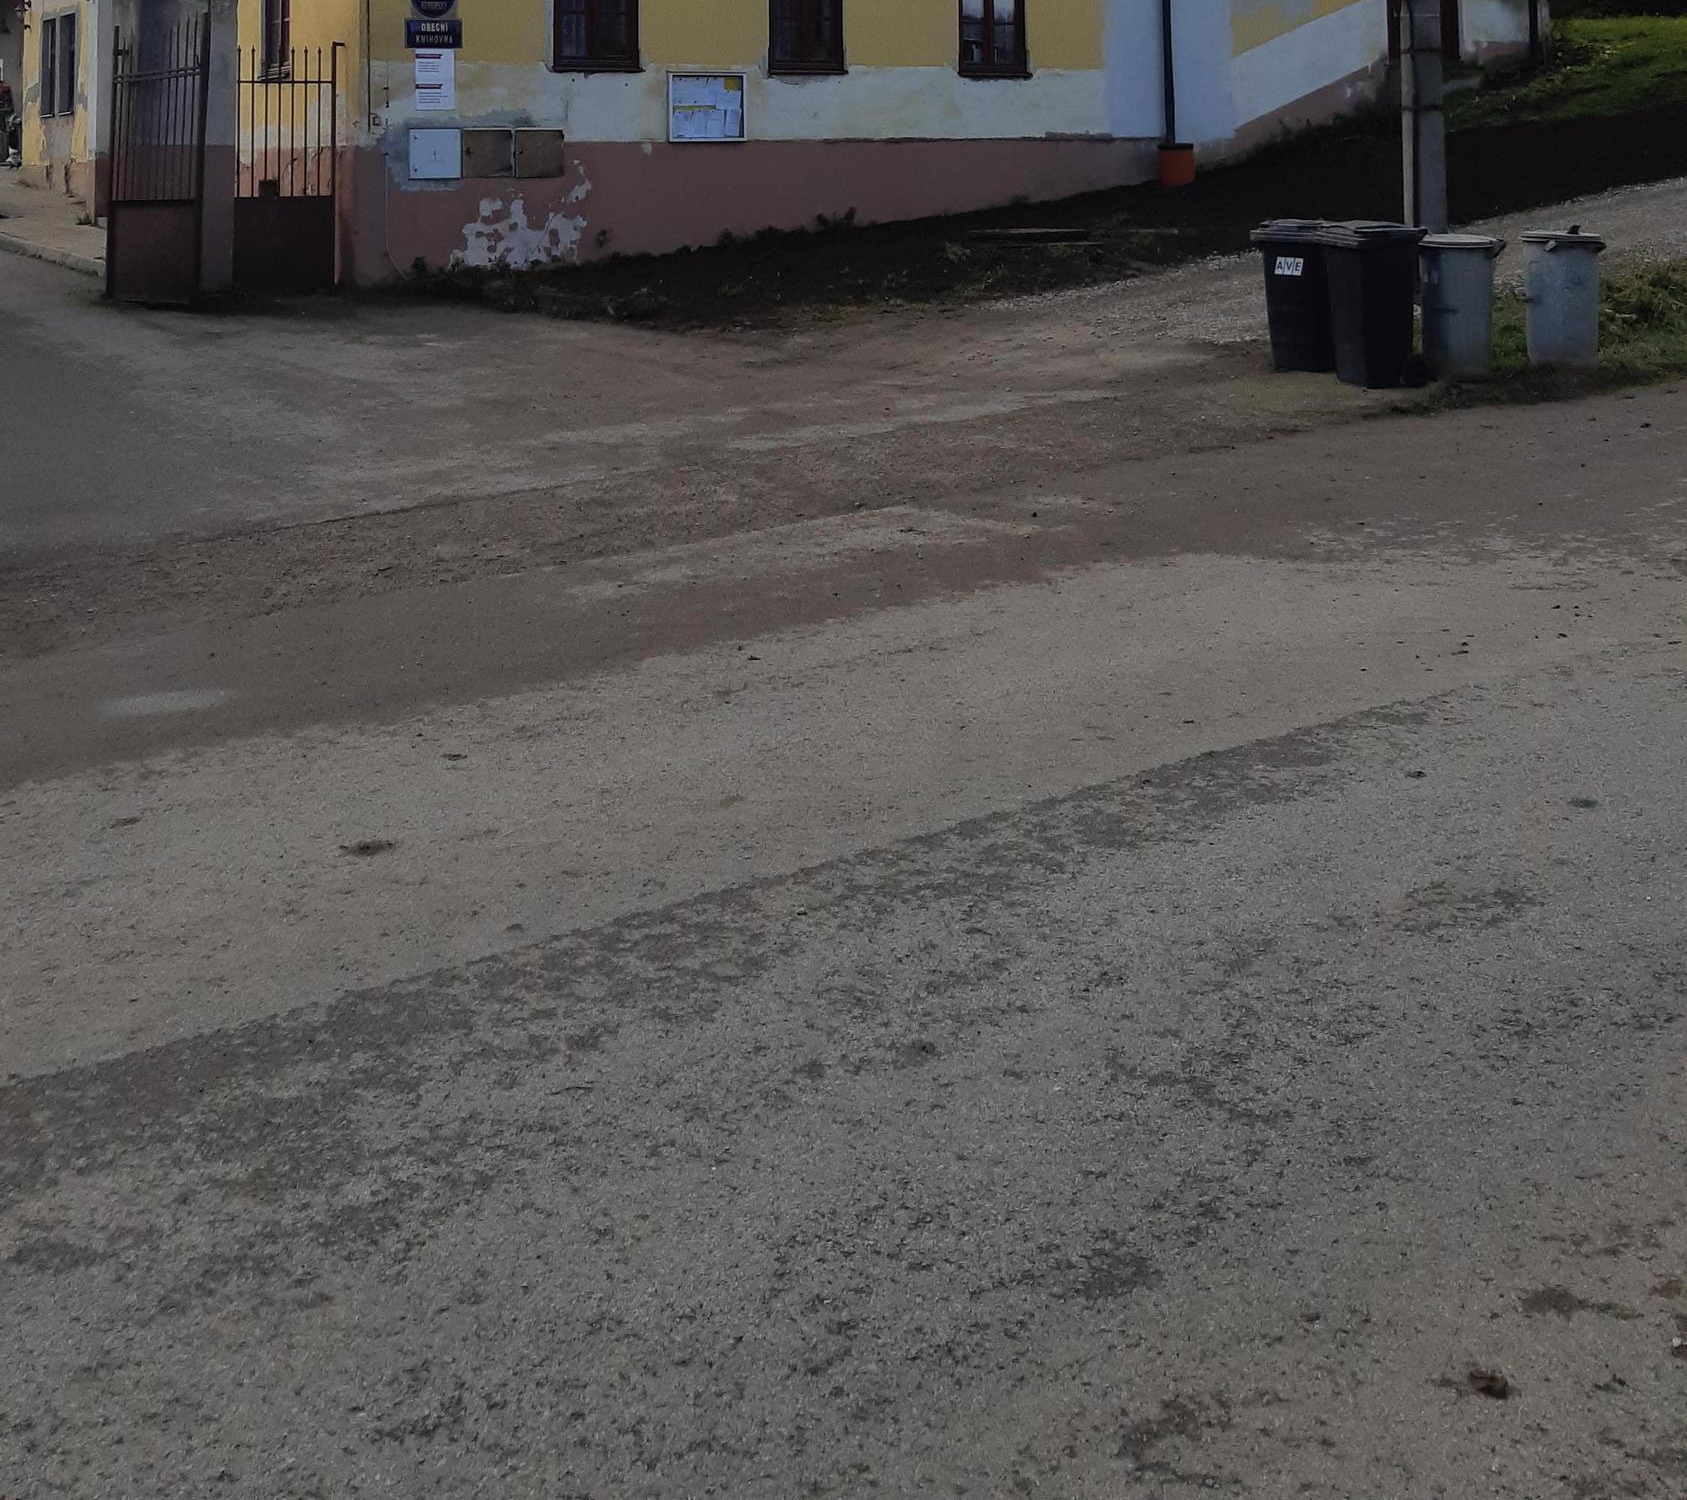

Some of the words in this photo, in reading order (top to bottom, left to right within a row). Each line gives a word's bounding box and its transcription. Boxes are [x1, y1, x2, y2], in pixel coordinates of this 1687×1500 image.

[421, 22, 448, 32] OBECNÍ
[415, 35, 453, 44] KNIHOVNA
[1277, 261, 1301, 271] AVE
